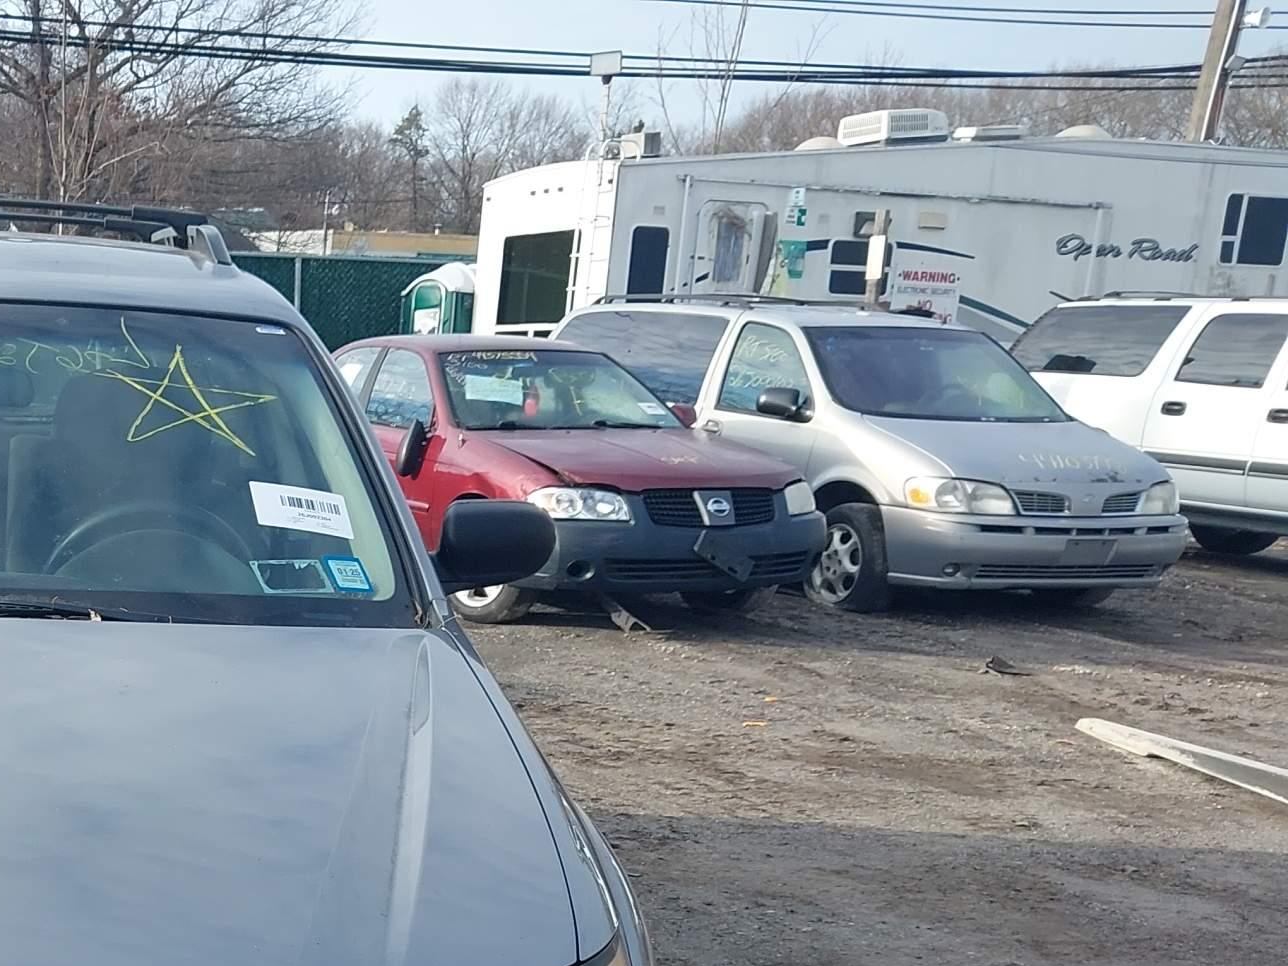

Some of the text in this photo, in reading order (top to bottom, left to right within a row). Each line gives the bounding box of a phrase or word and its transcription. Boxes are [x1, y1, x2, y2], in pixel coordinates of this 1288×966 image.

[1055, 232, 1200, 263] Open Road
[902, 270, 956, 283] WARNING
